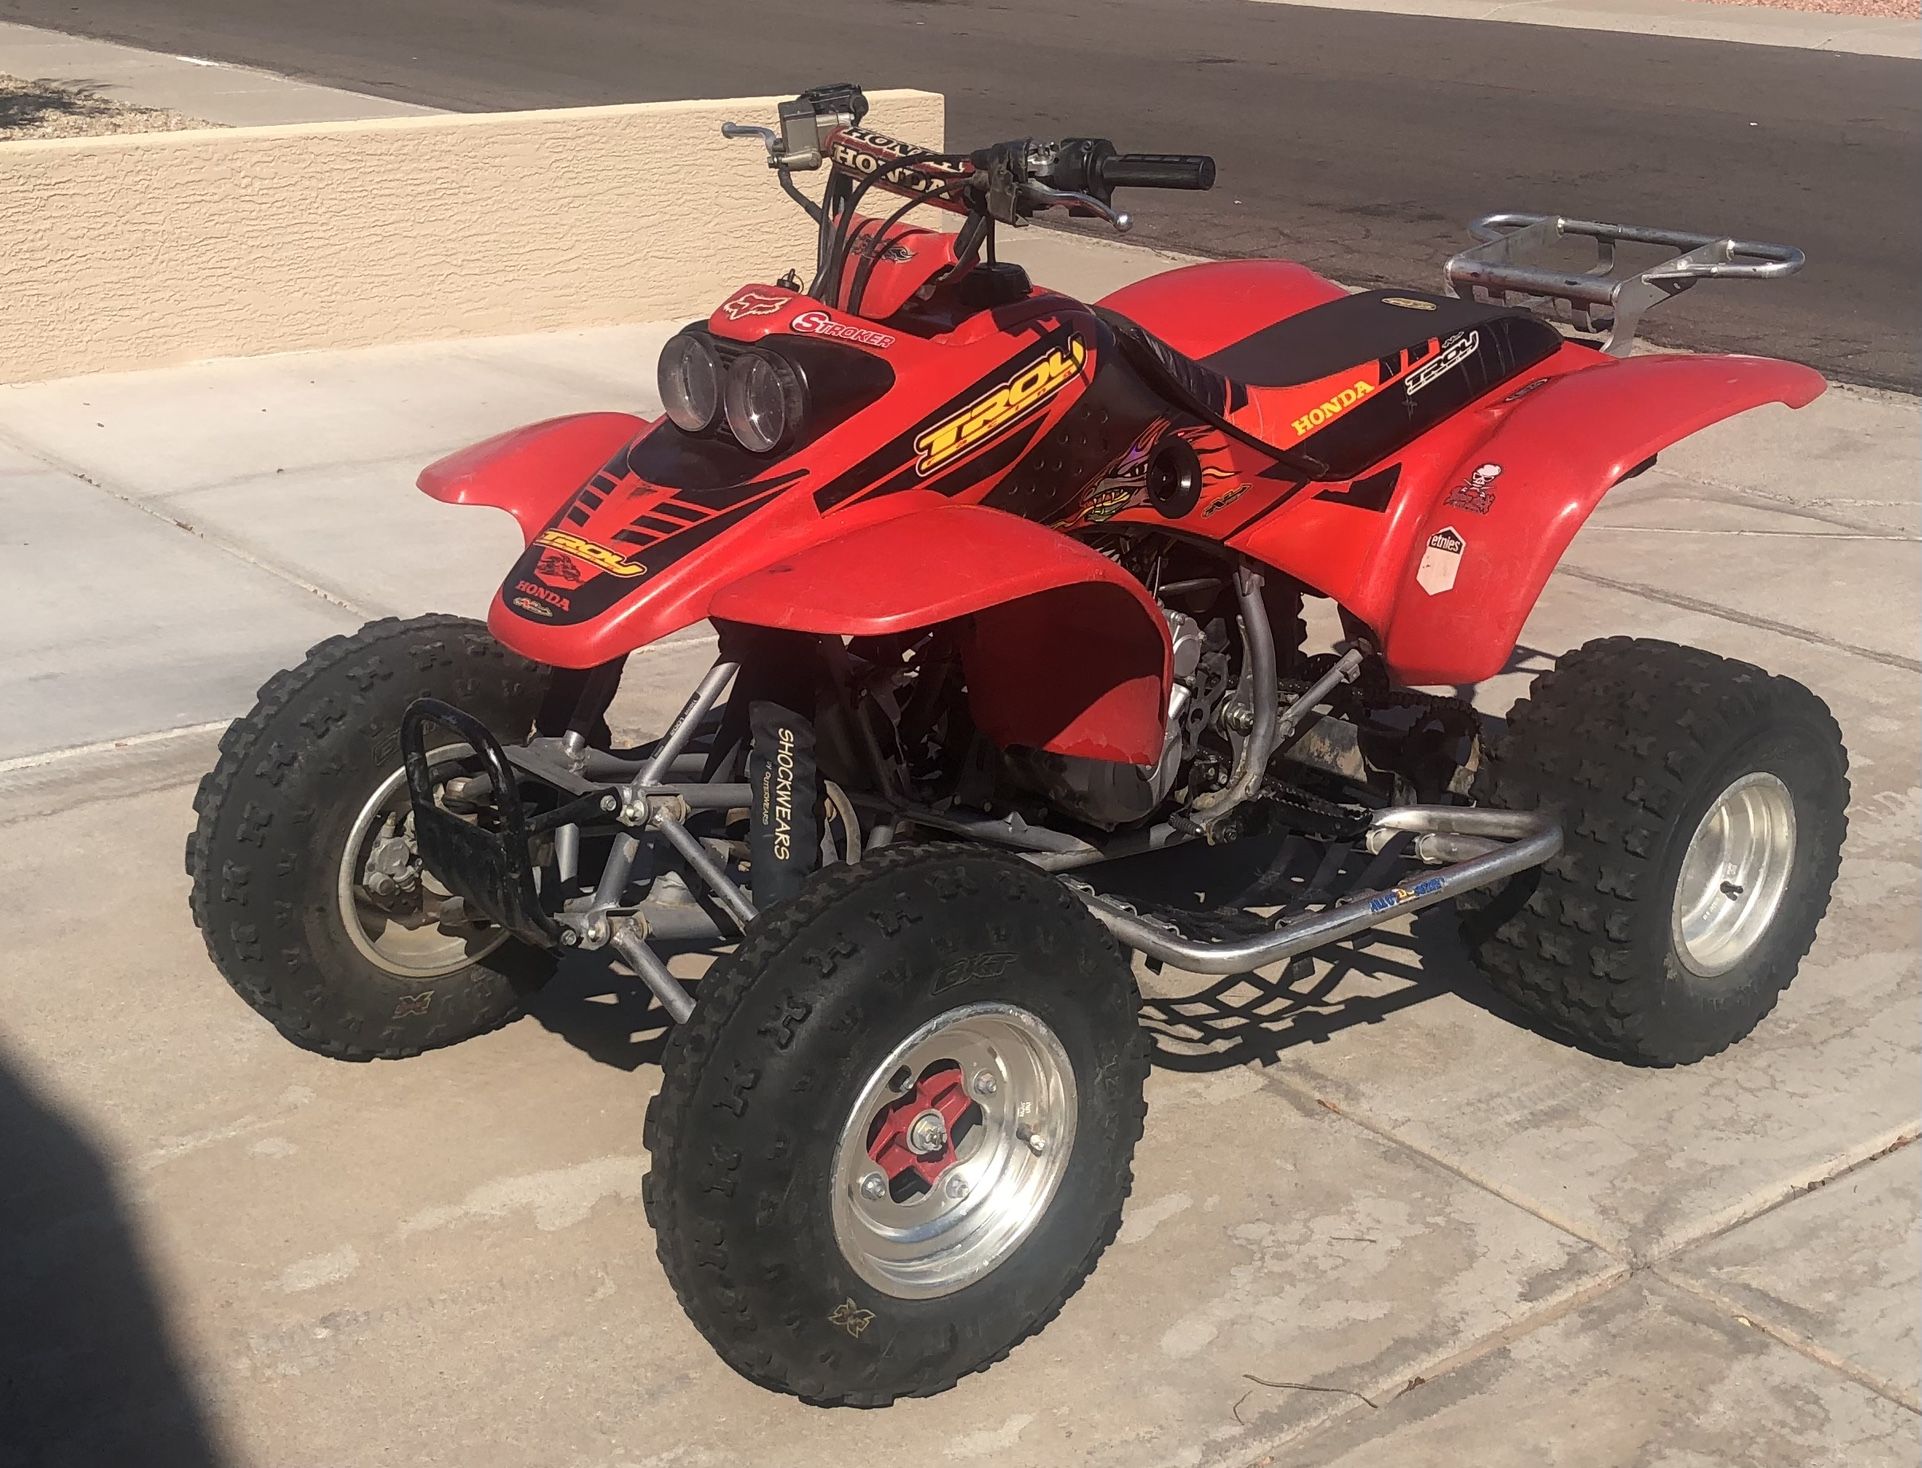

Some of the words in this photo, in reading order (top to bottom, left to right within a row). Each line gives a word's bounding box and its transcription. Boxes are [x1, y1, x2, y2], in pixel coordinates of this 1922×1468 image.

[789, 309, 896, 348] STROKER
[1405, 330, 1480, 394] TROY
[1290, 380, 1376, 436] HONDA
[1430, 533, 1462, 552] etnies
[515, 580, 572, 612] HONDA
[773, 726, 795, 861] SHOCKWEARS
